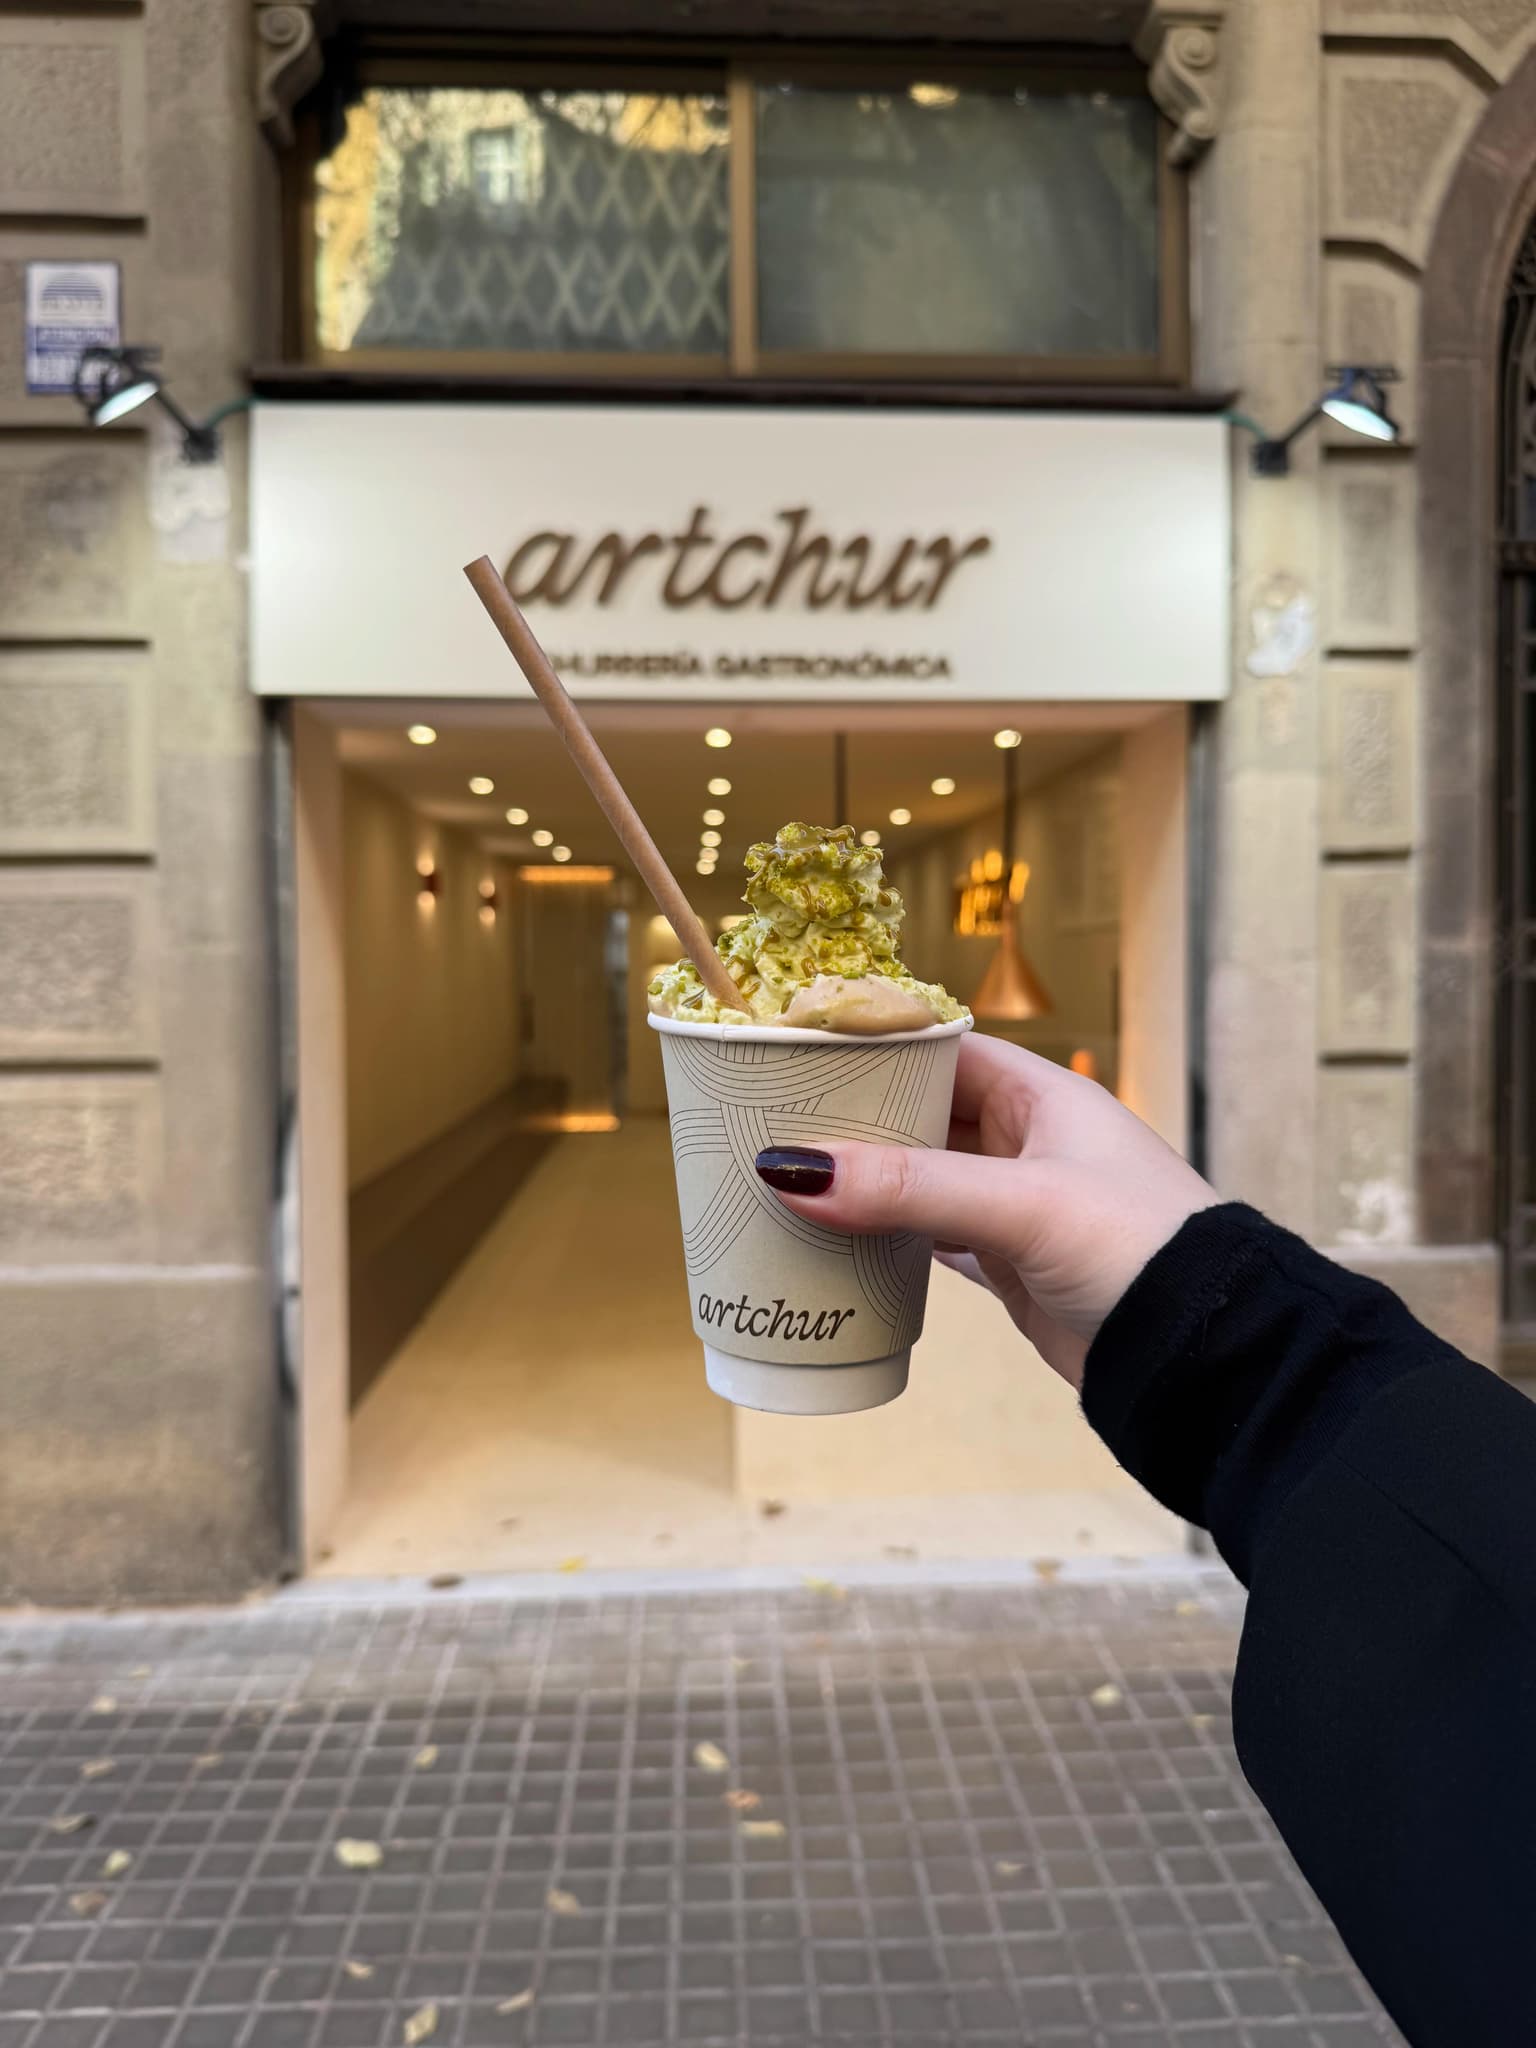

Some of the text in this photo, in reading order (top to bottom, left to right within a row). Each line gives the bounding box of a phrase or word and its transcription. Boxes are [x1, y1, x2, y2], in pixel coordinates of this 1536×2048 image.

[502, 506, 992, 609] artchur
[549, 648, 704, 676] HURRERÍA
[698, 1293, 856, 1341] artchur
